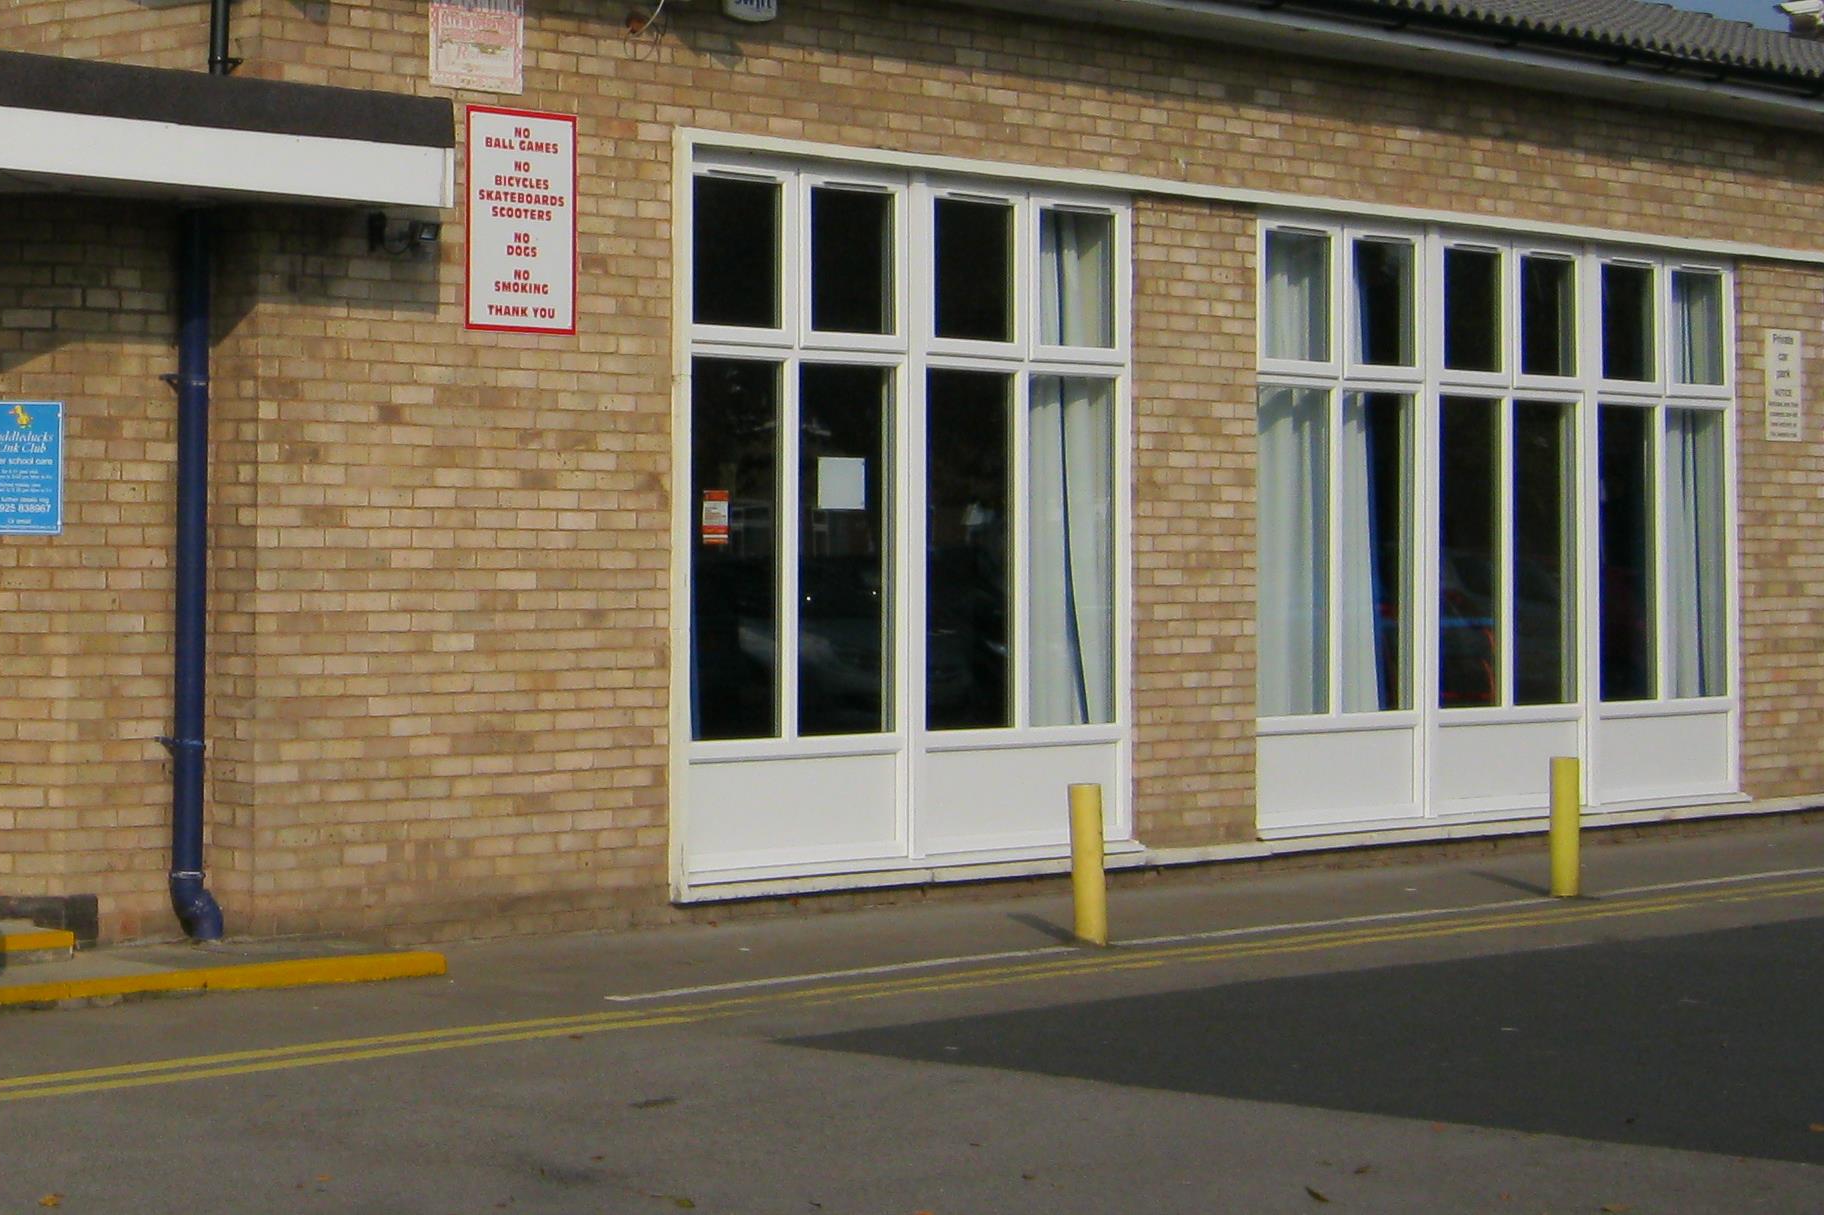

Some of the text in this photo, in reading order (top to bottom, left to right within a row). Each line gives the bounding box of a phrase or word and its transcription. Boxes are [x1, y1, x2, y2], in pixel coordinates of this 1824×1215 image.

[514, 127, 531, 139] NO
[485, 136, 559, 154] BALL GAMES
[514, 161, 531, 173] NO
[494, 175, 550, 190] BICYCLES
[478, 189, 565, 207] SKATEBOARDS
[492, 206, 552, 221] SCOOTERS
[514, 232, 530, 244] NO
[506, 245, 537, 257] DOGS
[514, 269, 530, 281] NO
[494, 281, 549, 295] SMOKING
[487, 304, 555, 319] THANK YOU
[21, 442, 47, 453] Club
[8, 457, 34, 465] school
